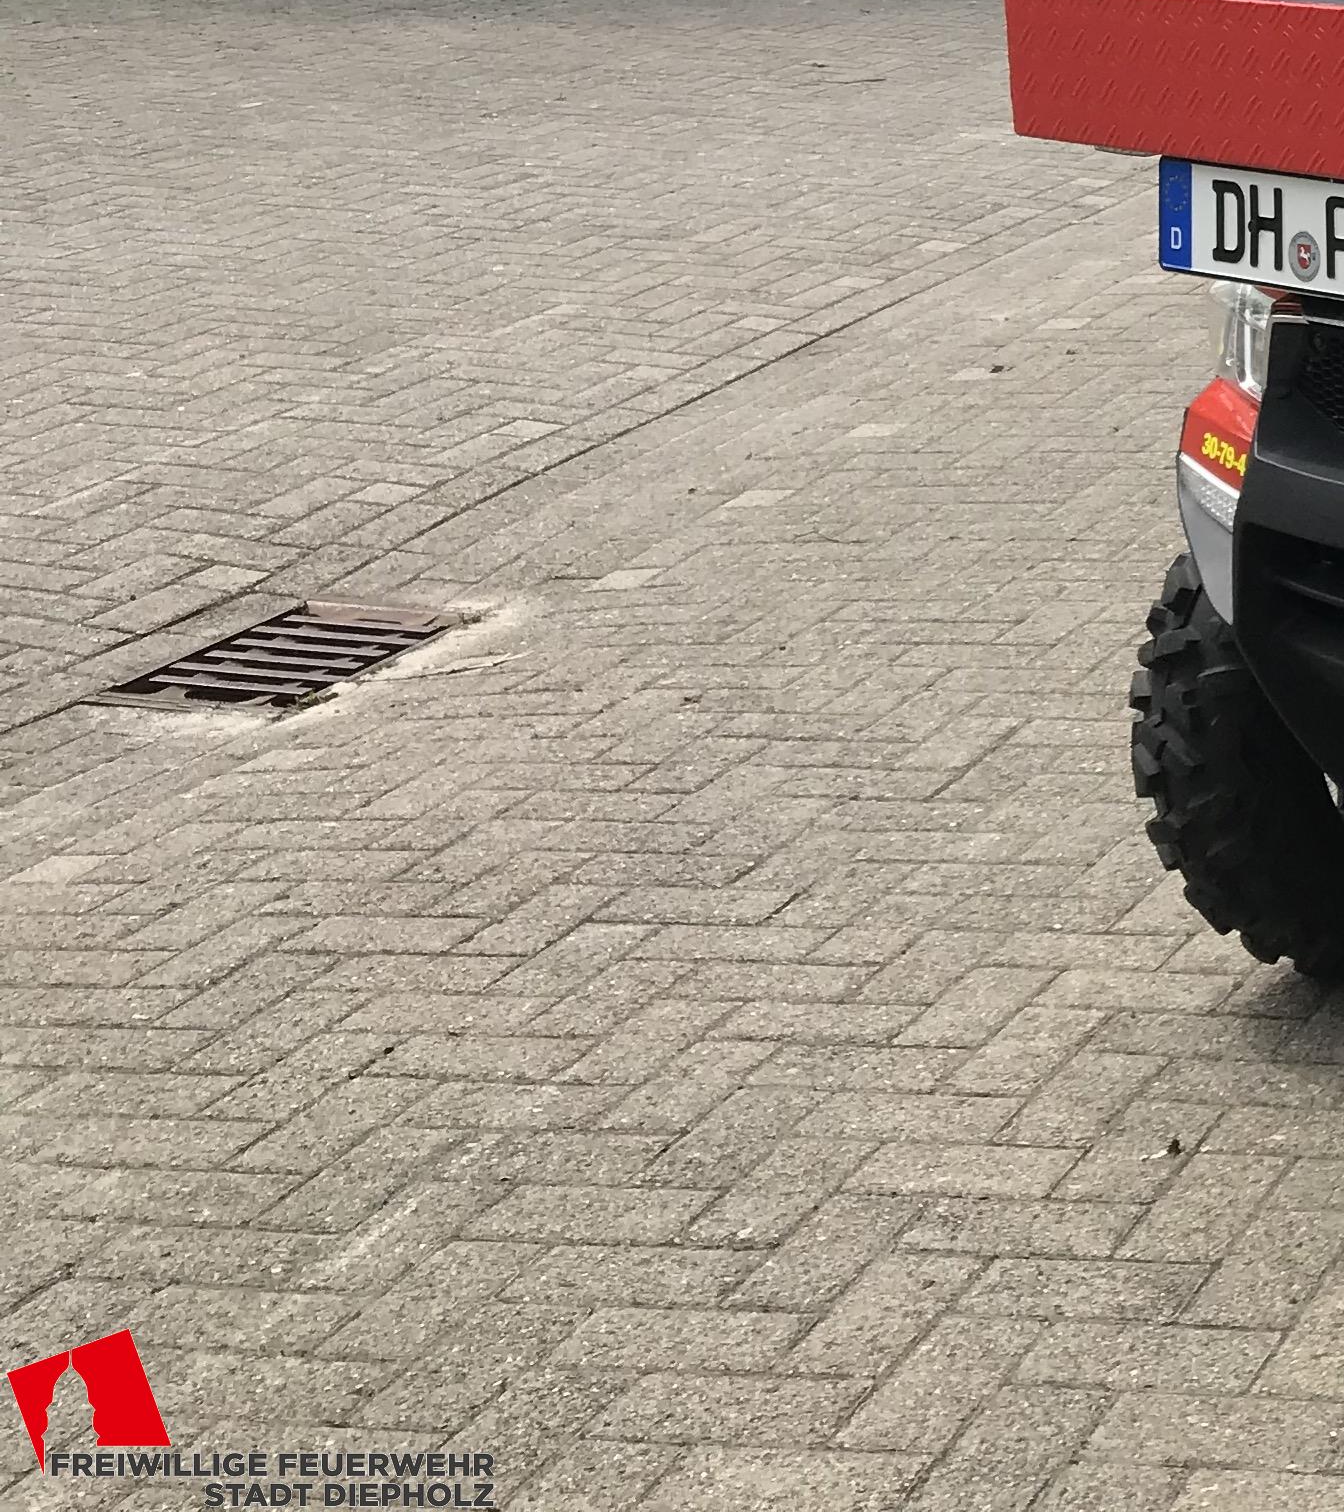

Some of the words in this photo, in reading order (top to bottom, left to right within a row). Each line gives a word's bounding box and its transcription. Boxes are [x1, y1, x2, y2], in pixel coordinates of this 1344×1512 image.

[1170, 226, 1182, 250] D
[1211, 179, 1283, 272] DH
[1201, 432, 1248, 477] 30-79-4
